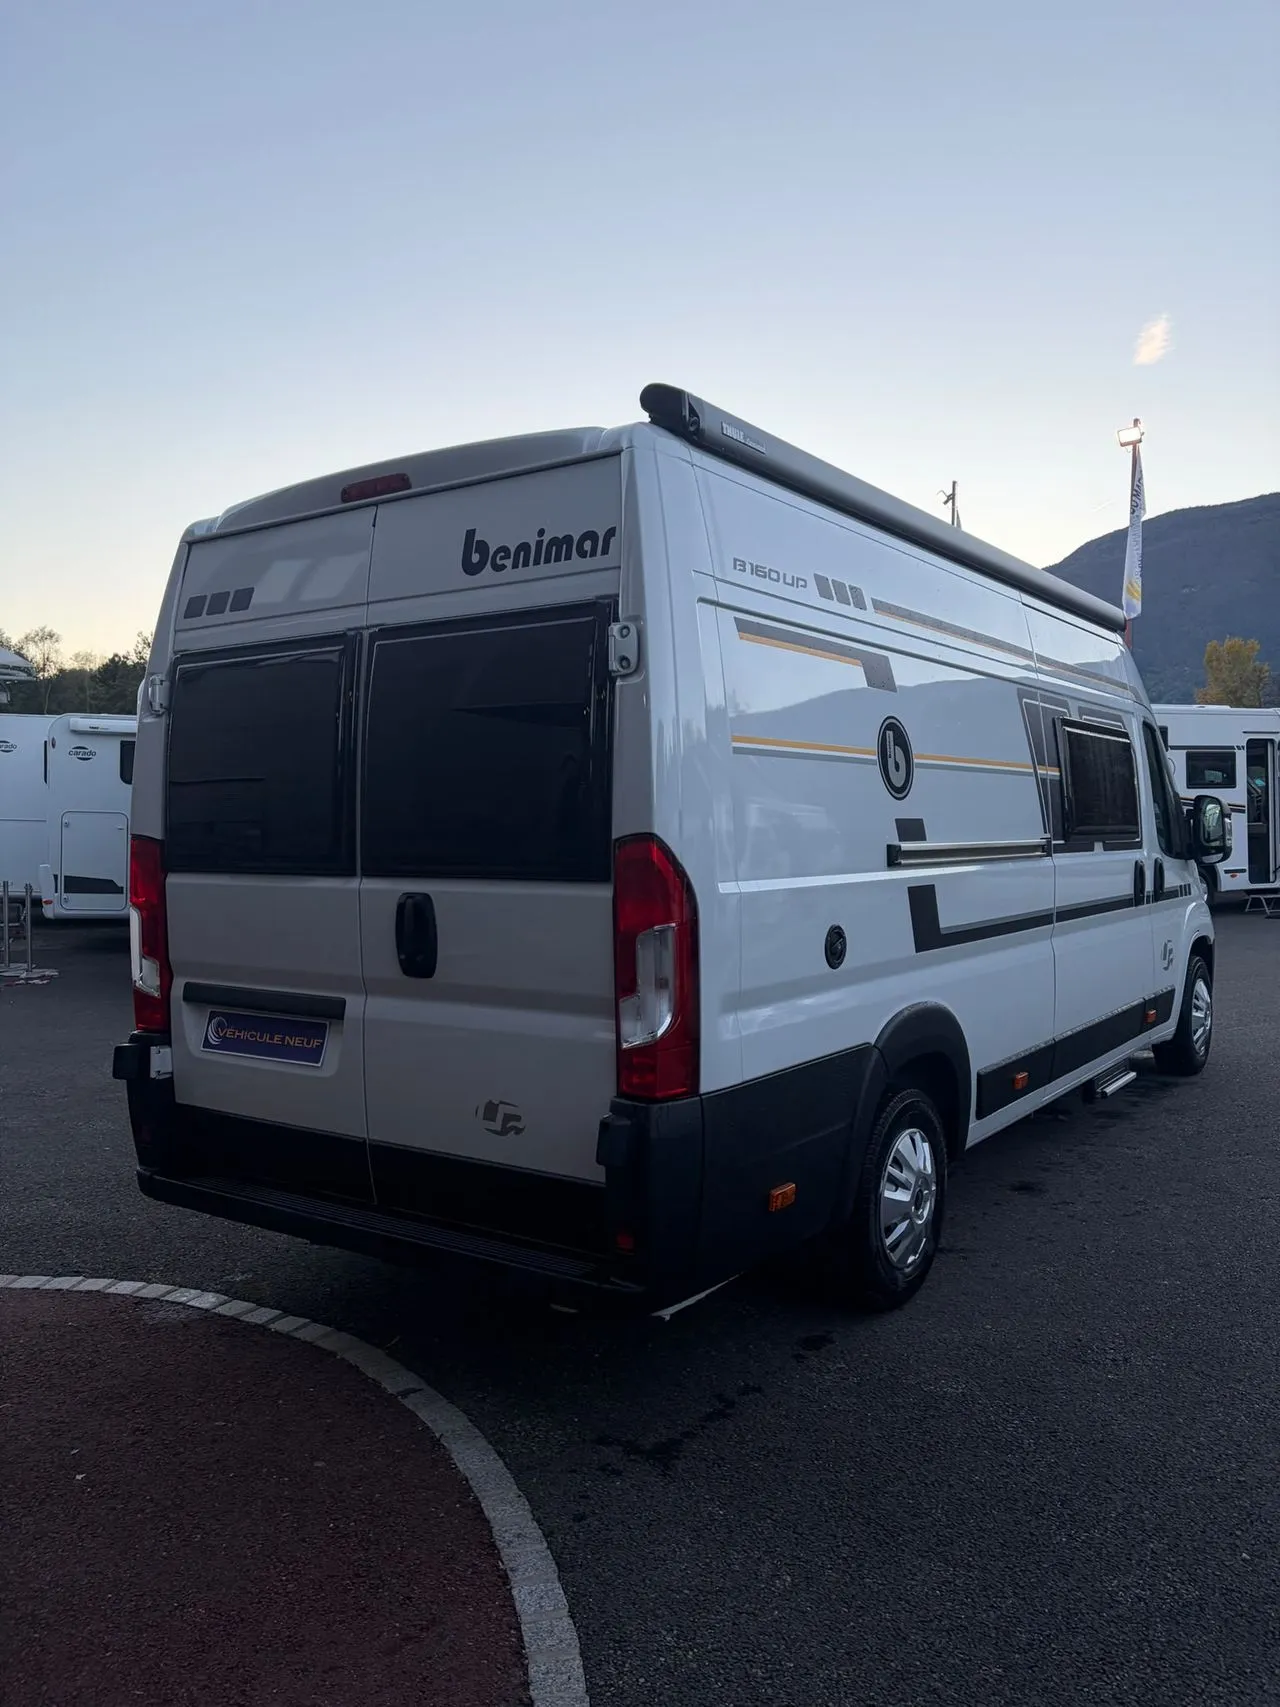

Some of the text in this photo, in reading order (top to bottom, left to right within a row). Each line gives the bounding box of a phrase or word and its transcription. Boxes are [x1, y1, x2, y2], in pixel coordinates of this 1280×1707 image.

[461, 526, 617, 576] benimar
[68, 748, 97, 758] carado
[285, 1035, 323, 1049] NEUF
